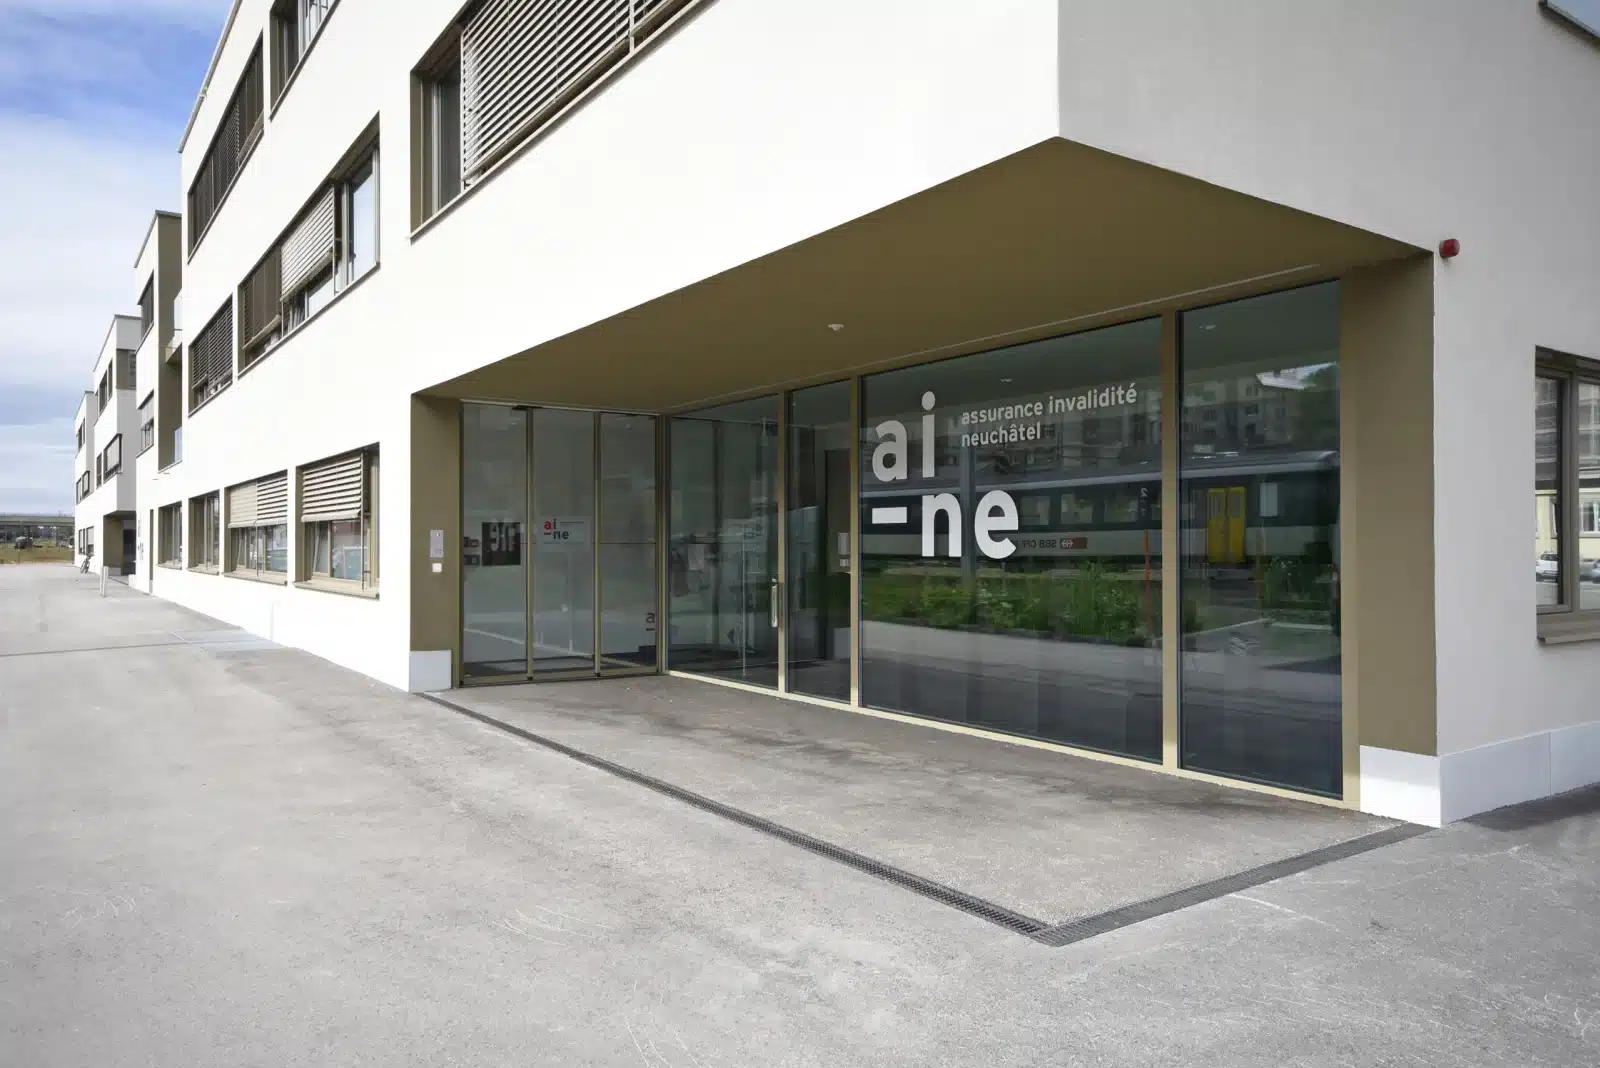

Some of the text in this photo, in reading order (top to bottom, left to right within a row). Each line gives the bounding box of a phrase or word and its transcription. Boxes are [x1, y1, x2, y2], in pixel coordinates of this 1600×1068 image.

[961, 383, 1138, 425] assurance invalidité
[872, 391, 936, 482] ai
[961, 422, 1042, 447] neuchâtel
